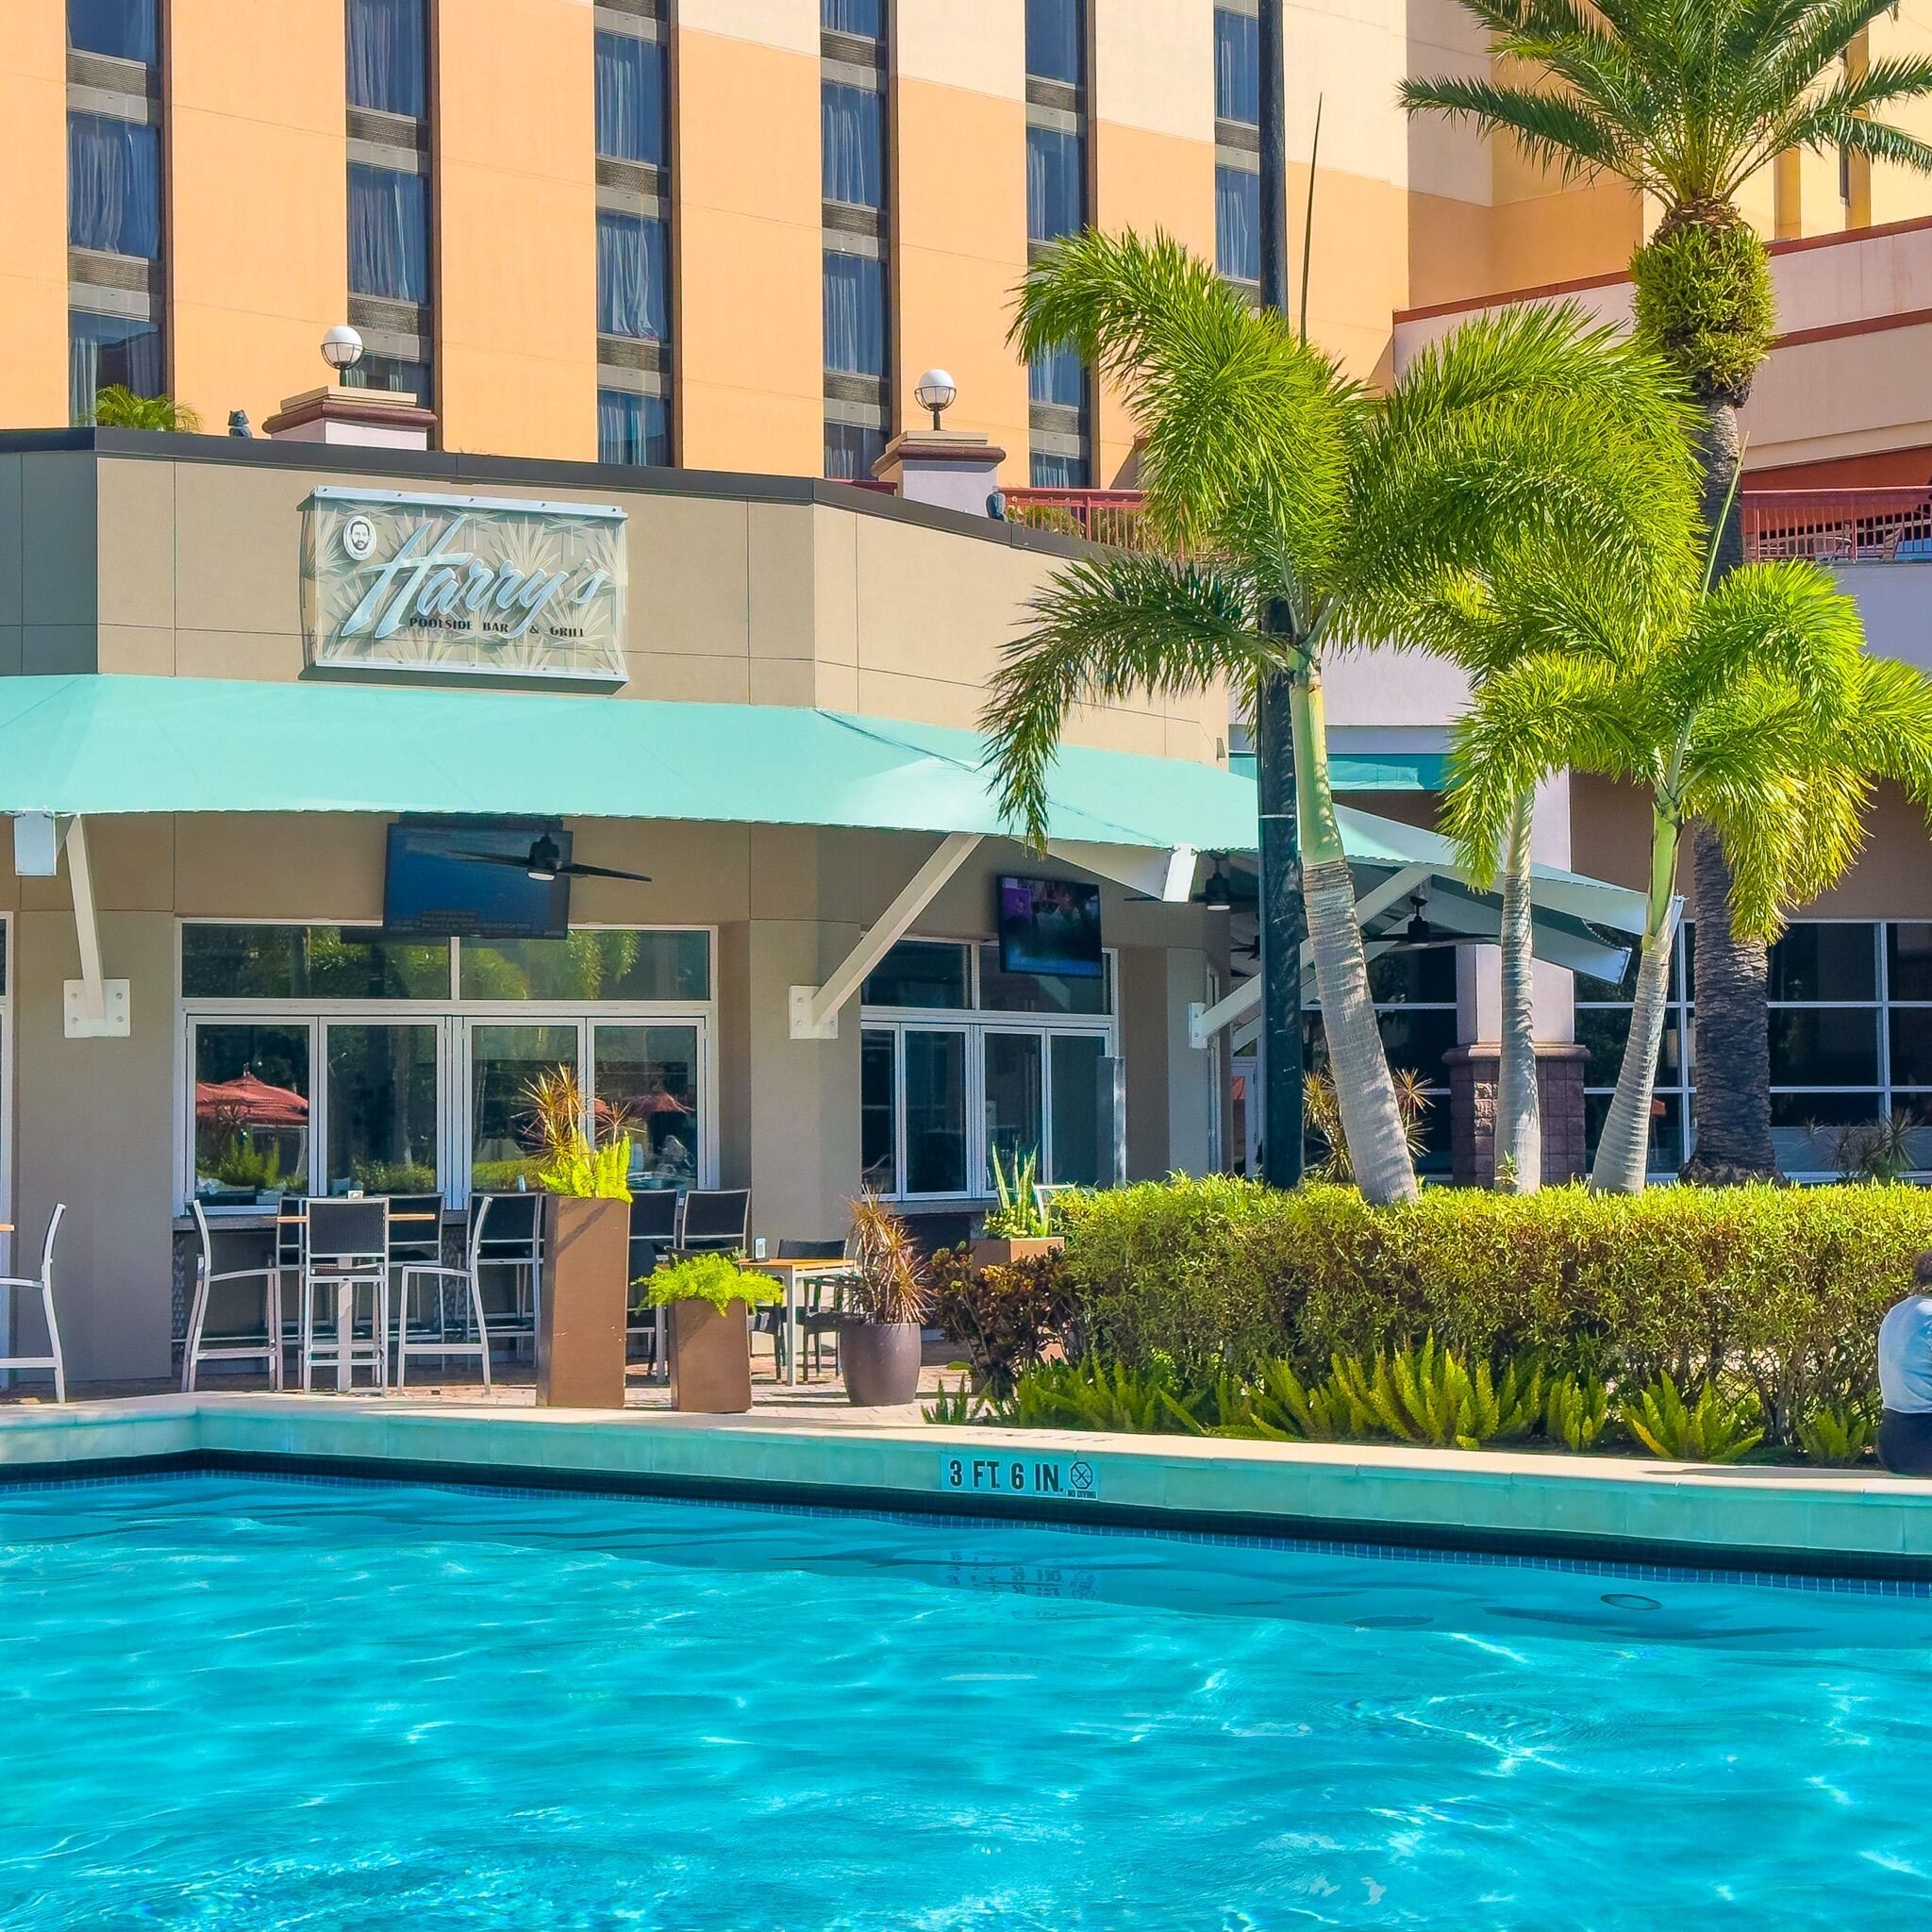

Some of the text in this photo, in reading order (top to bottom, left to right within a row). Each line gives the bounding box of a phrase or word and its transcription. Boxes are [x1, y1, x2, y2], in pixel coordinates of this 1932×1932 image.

[341, 513, 610, 640] Harry's
[408, 617, 585, 638] POOLSIDE BAR & GRILL
[949, 1459, 1064, 1493] 3 FT. 6 IN.
